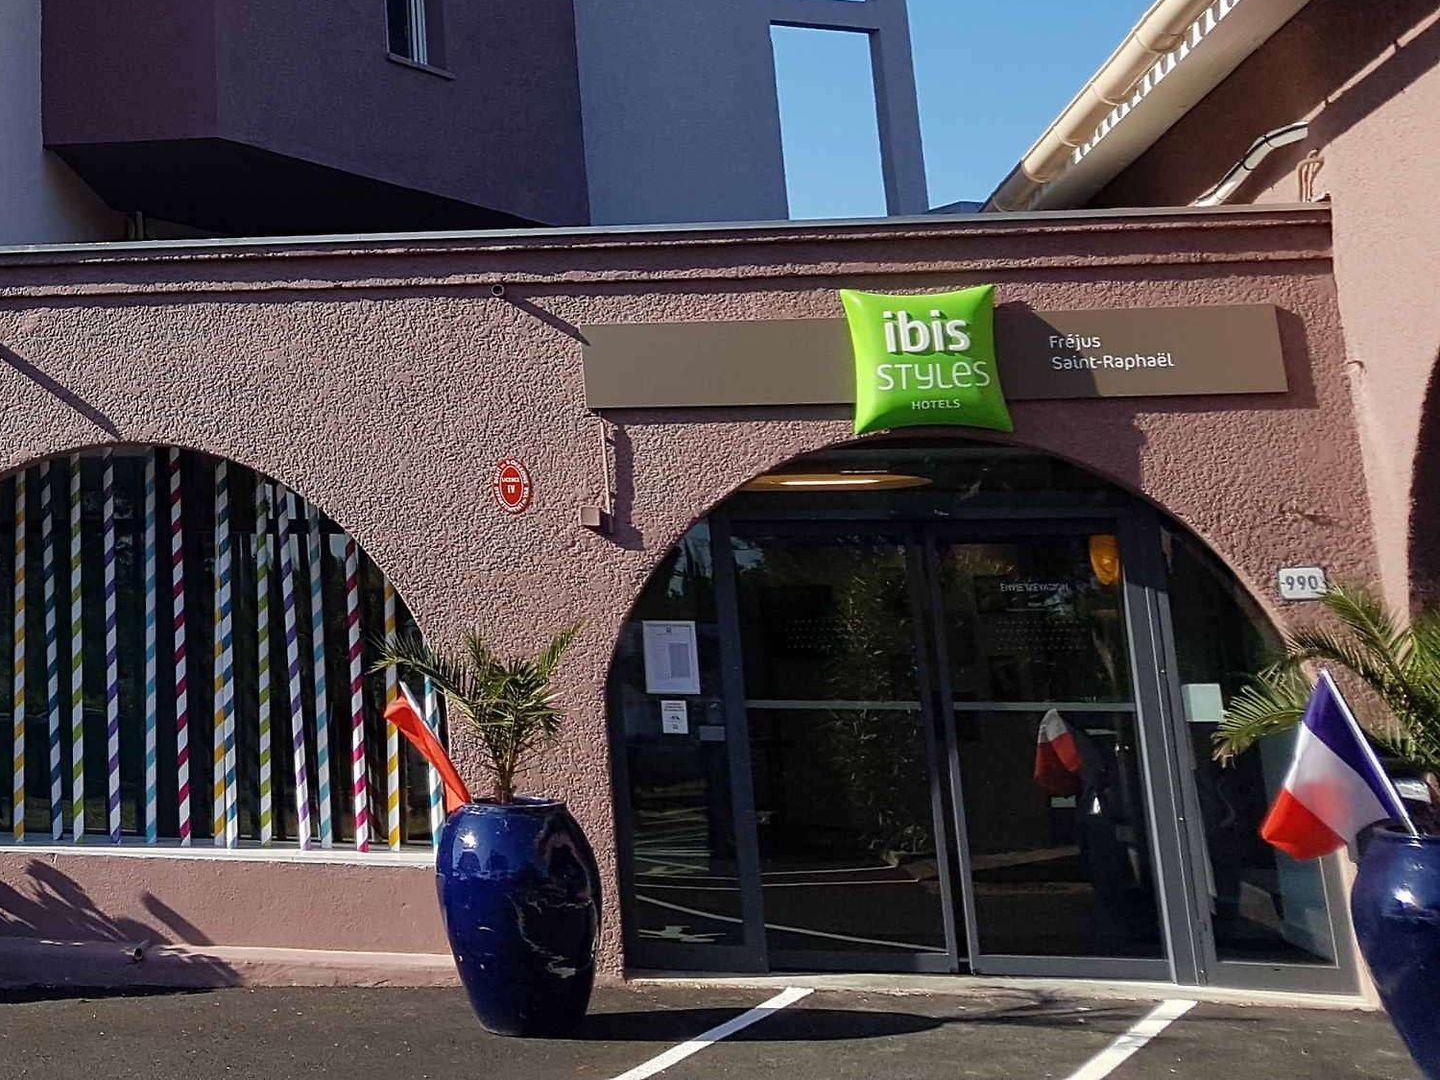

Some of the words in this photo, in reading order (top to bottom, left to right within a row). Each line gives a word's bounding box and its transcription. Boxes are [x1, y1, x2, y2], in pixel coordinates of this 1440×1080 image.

[882, 309, 972, 354] ibis
[1049, 334, 1101, 351] Fréjus
[1051, 352, 1175, 371] Saint-Raphaël
[911, 398, 961, 411] HOTELS
[507, 484, 516, 494] IV
[1285, 575, 1318, 591] 990
